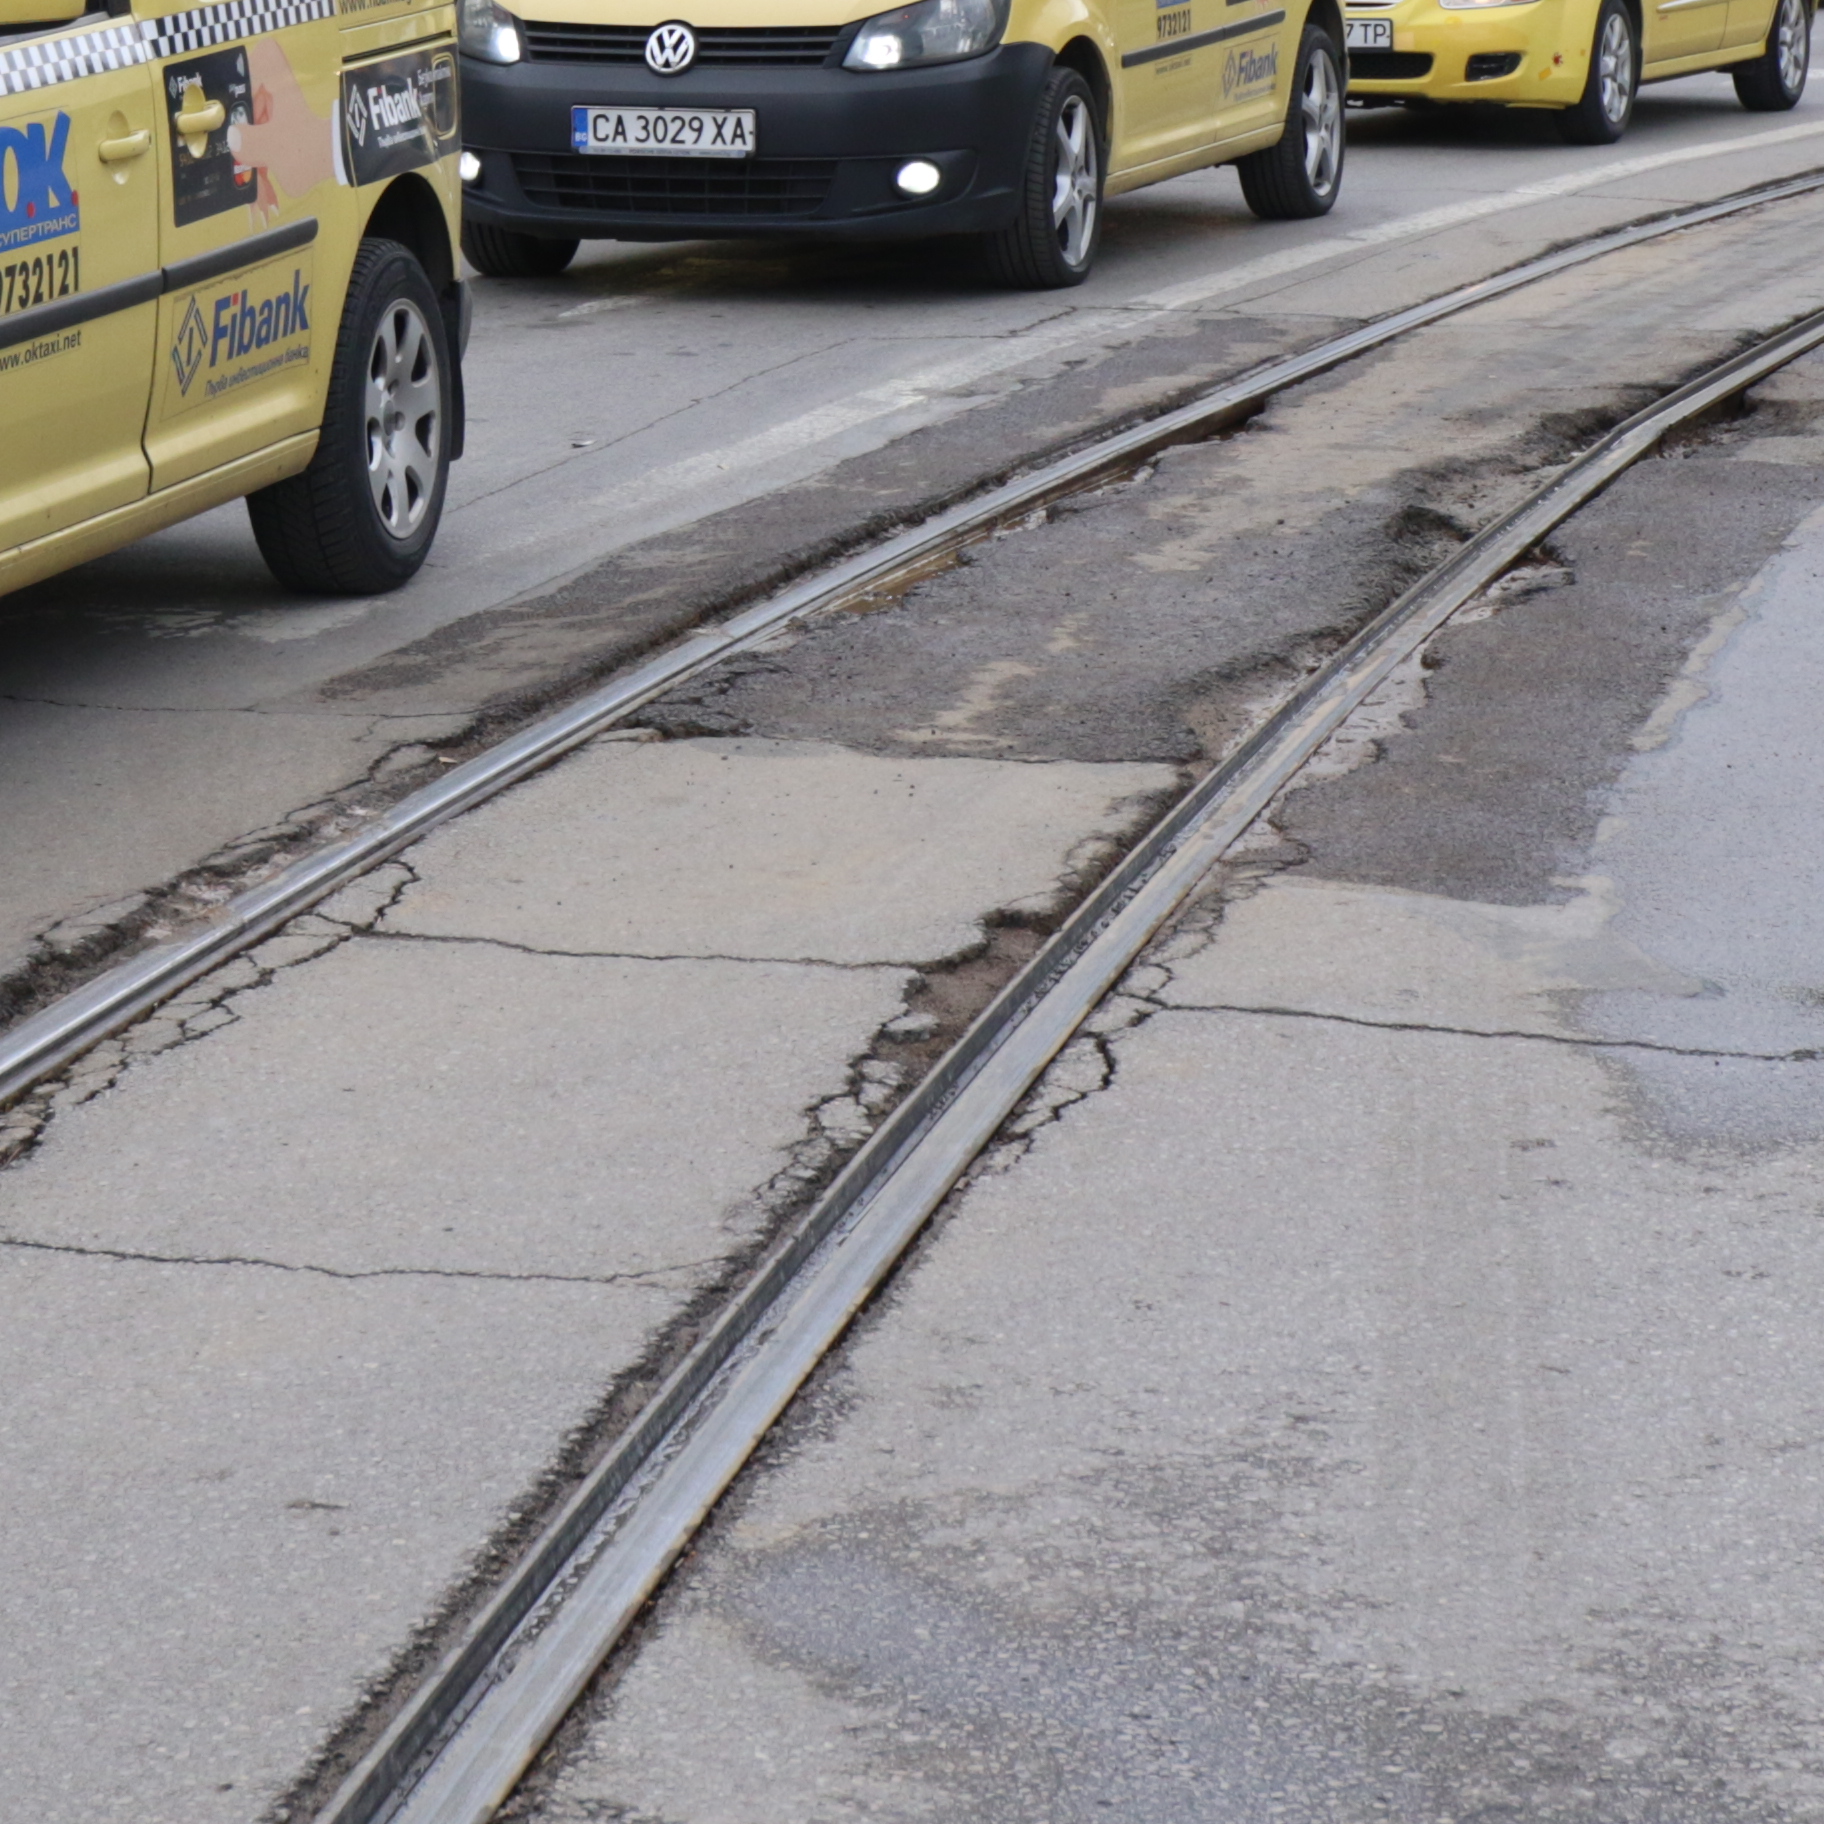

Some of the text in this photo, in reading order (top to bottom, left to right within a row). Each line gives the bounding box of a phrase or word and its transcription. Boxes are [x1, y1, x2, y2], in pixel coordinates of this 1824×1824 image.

[1157, 9, 1190, 39] 9732121
[1237, 43, 1279, 87] Fibank
[367, 78, 422, 131] Fibank
[635, 115, 704, 144] 3029
[209, 269, 310, 368] Fibank
